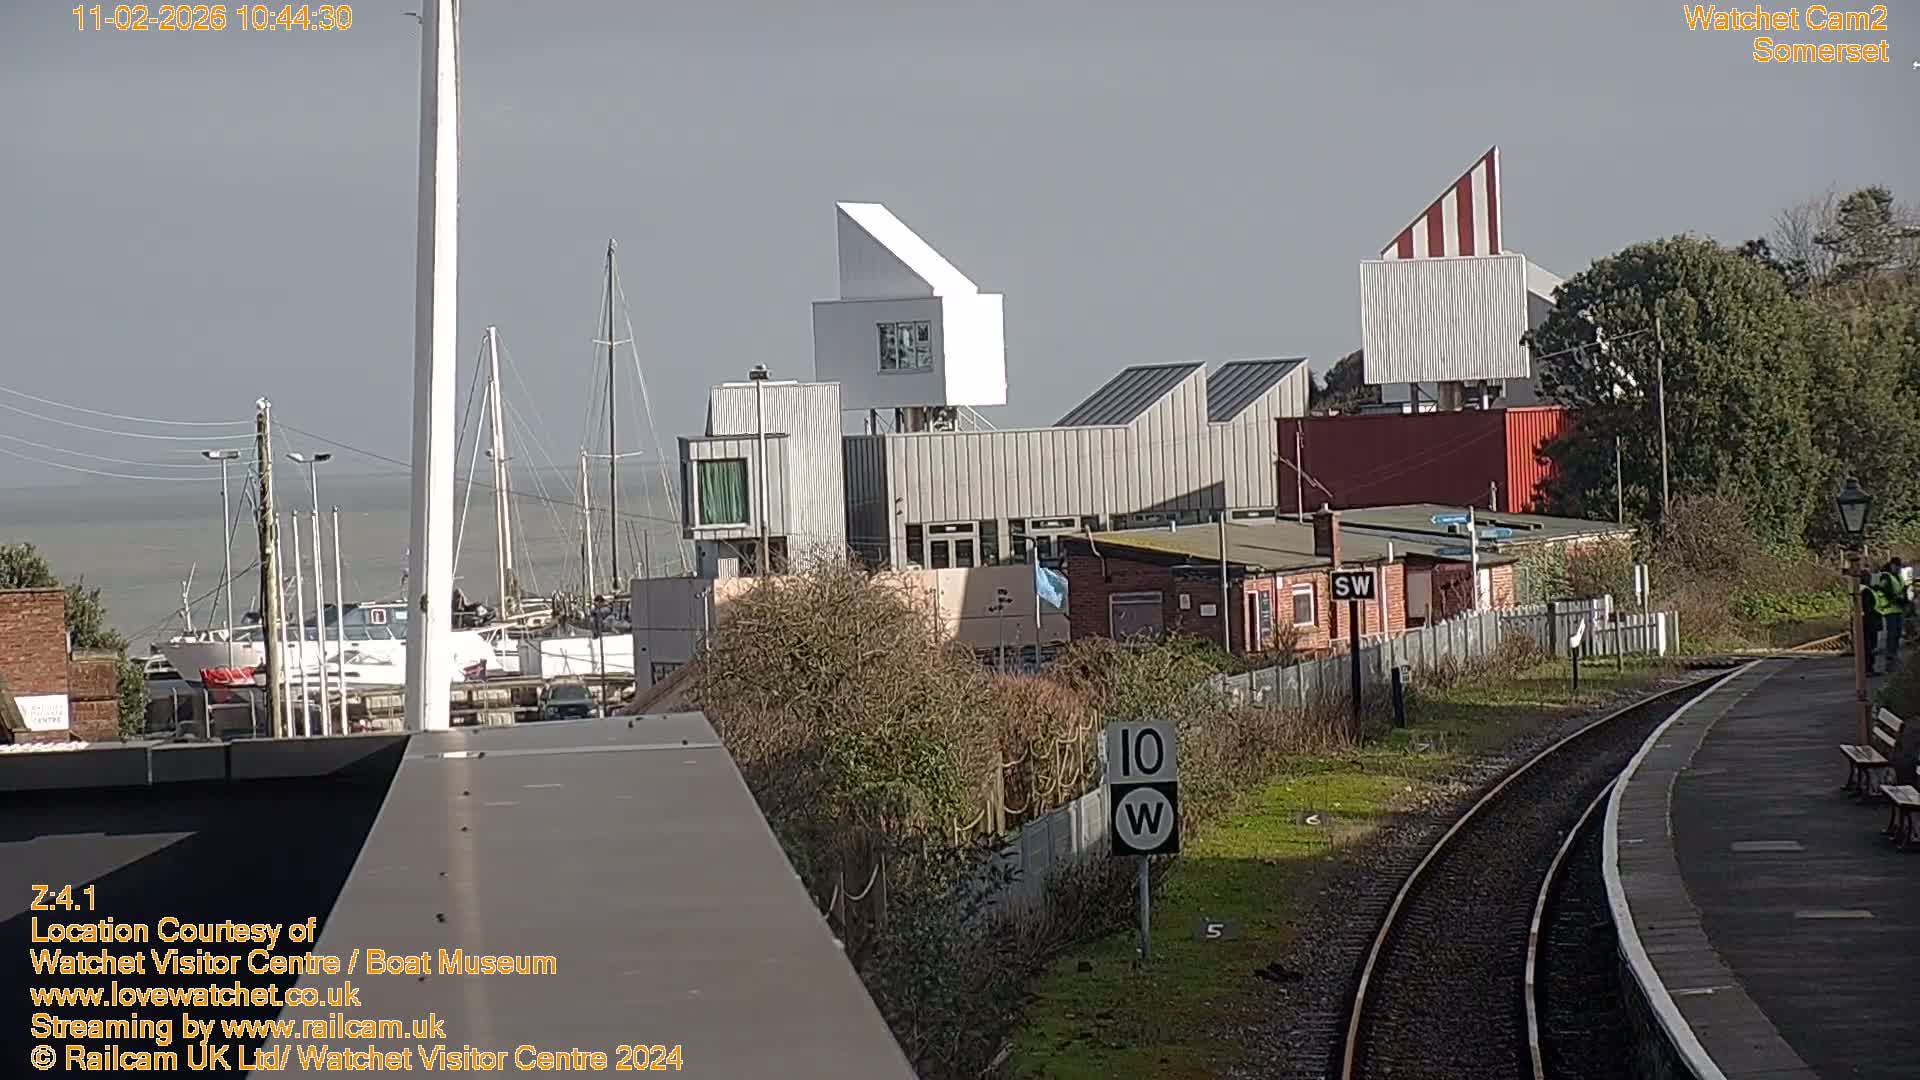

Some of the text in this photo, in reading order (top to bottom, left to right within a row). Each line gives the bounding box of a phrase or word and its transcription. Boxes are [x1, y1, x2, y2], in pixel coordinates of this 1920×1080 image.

[1335, 576, 1370, 596] SW
[1121, 728, 1164, 776] 10
[1125, 802, 1164, 835] W
[1305, 814, 1321, 826] 6
[1206, 923, 1223, 939] 5
